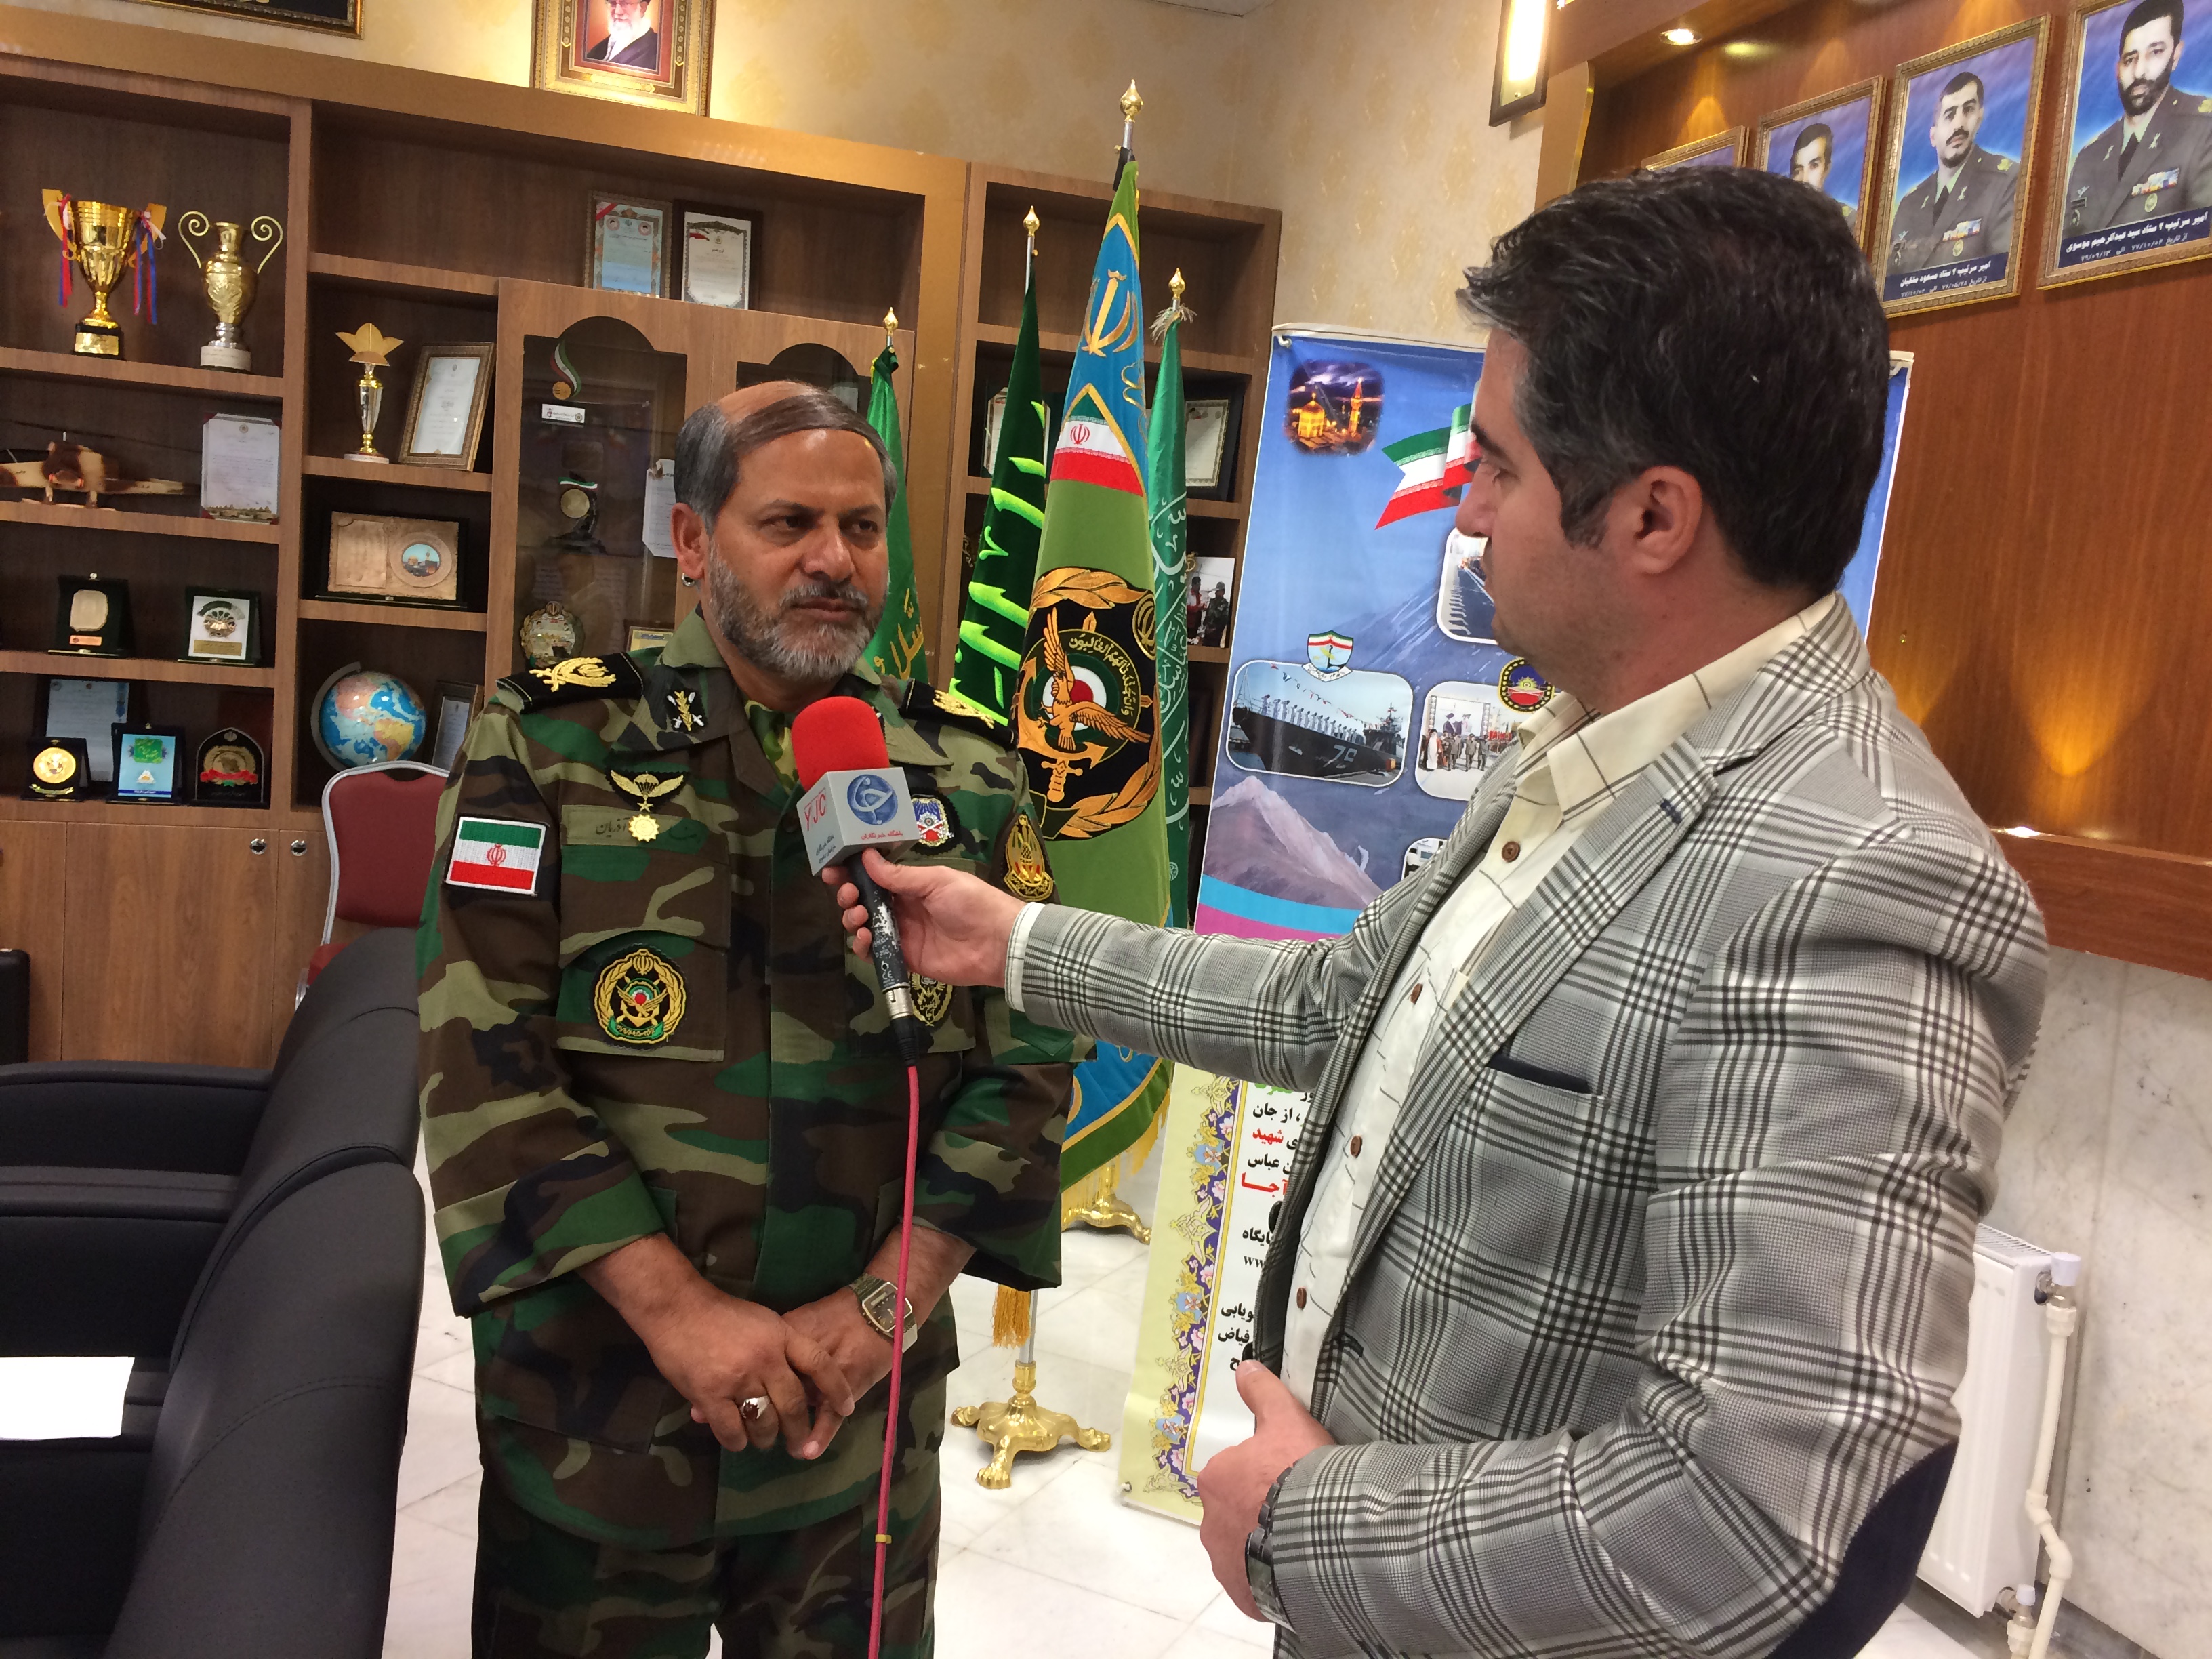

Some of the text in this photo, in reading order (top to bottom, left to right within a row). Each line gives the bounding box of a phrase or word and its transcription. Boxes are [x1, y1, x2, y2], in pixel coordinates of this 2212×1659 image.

[804, 794, 826, 832] YJC
[1252, 1102, 1293, 1124] از جان
[1252, 1128, 1284, 1145] شهید
[1247, 1153, 1279, 1171] عباس
[1218, 1326, 1250, 1346] فیاض
